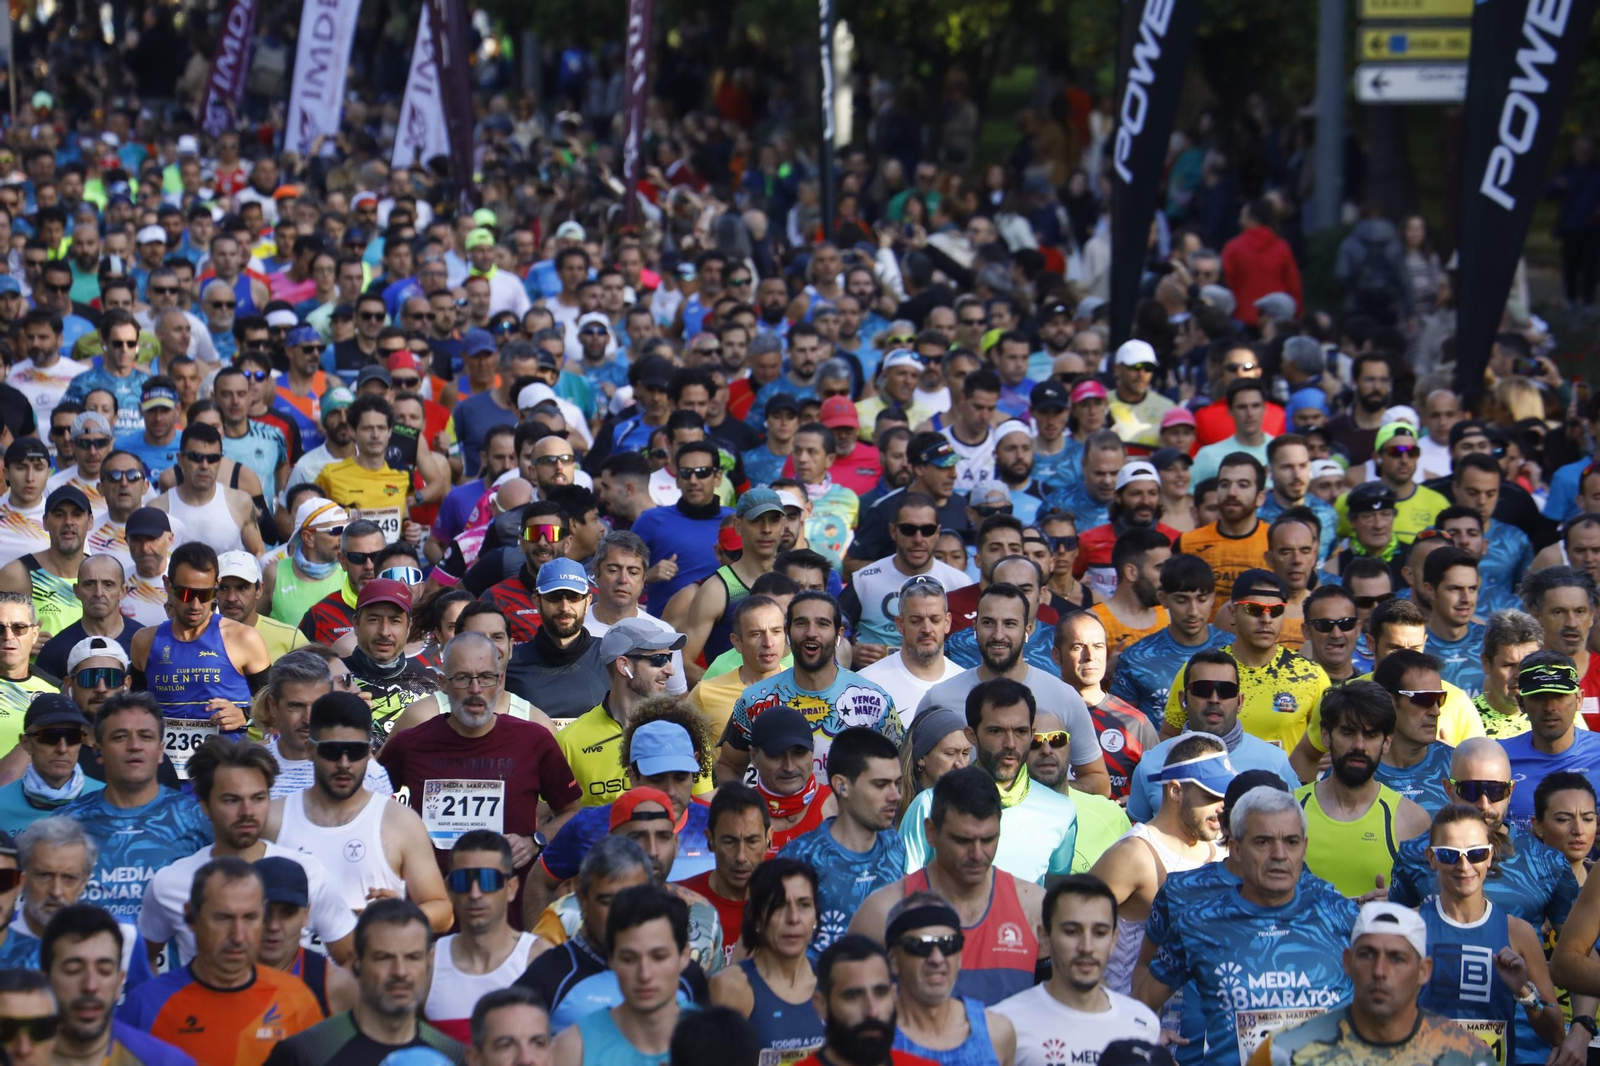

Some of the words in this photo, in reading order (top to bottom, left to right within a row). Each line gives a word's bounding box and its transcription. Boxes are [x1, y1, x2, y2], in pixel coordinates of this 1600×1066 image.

[213, 0, 255, 91] IMD
[568, 575, 587, 584] SPORT
[155, 674, 221, 683] FUENTES
[155, 684, 185, 692] TRIATLÓN
[851, 696, 881, 706] VENGA
[800, 707, 826, 716] BRA!!
[165, 732, 212, 751] 236
[582, 745, 603, 754] vive
[1110, 775, 1127, 787] PORT
[426, 782, 441, 796] 38
[441, 795, 501, 817] 2177
[101, 866, 156, 883] MEDIA
[103, 884, 144, 900] MAR
[102, 905, 142, 915] ORDO
[1248, 970, 1311, 990] MEDIA
[1216, 986, 1249, 1011] 38
[1250, 984, 1341, 1009] MARATÓN
[1239, 1014, 1257, 1029] 38
[1258, 1013, 1283, 1021] MEDIA
[1285, 1009, 1320, 1020] MARATÓ
[1071, 1050, 1102, 1065] MED
